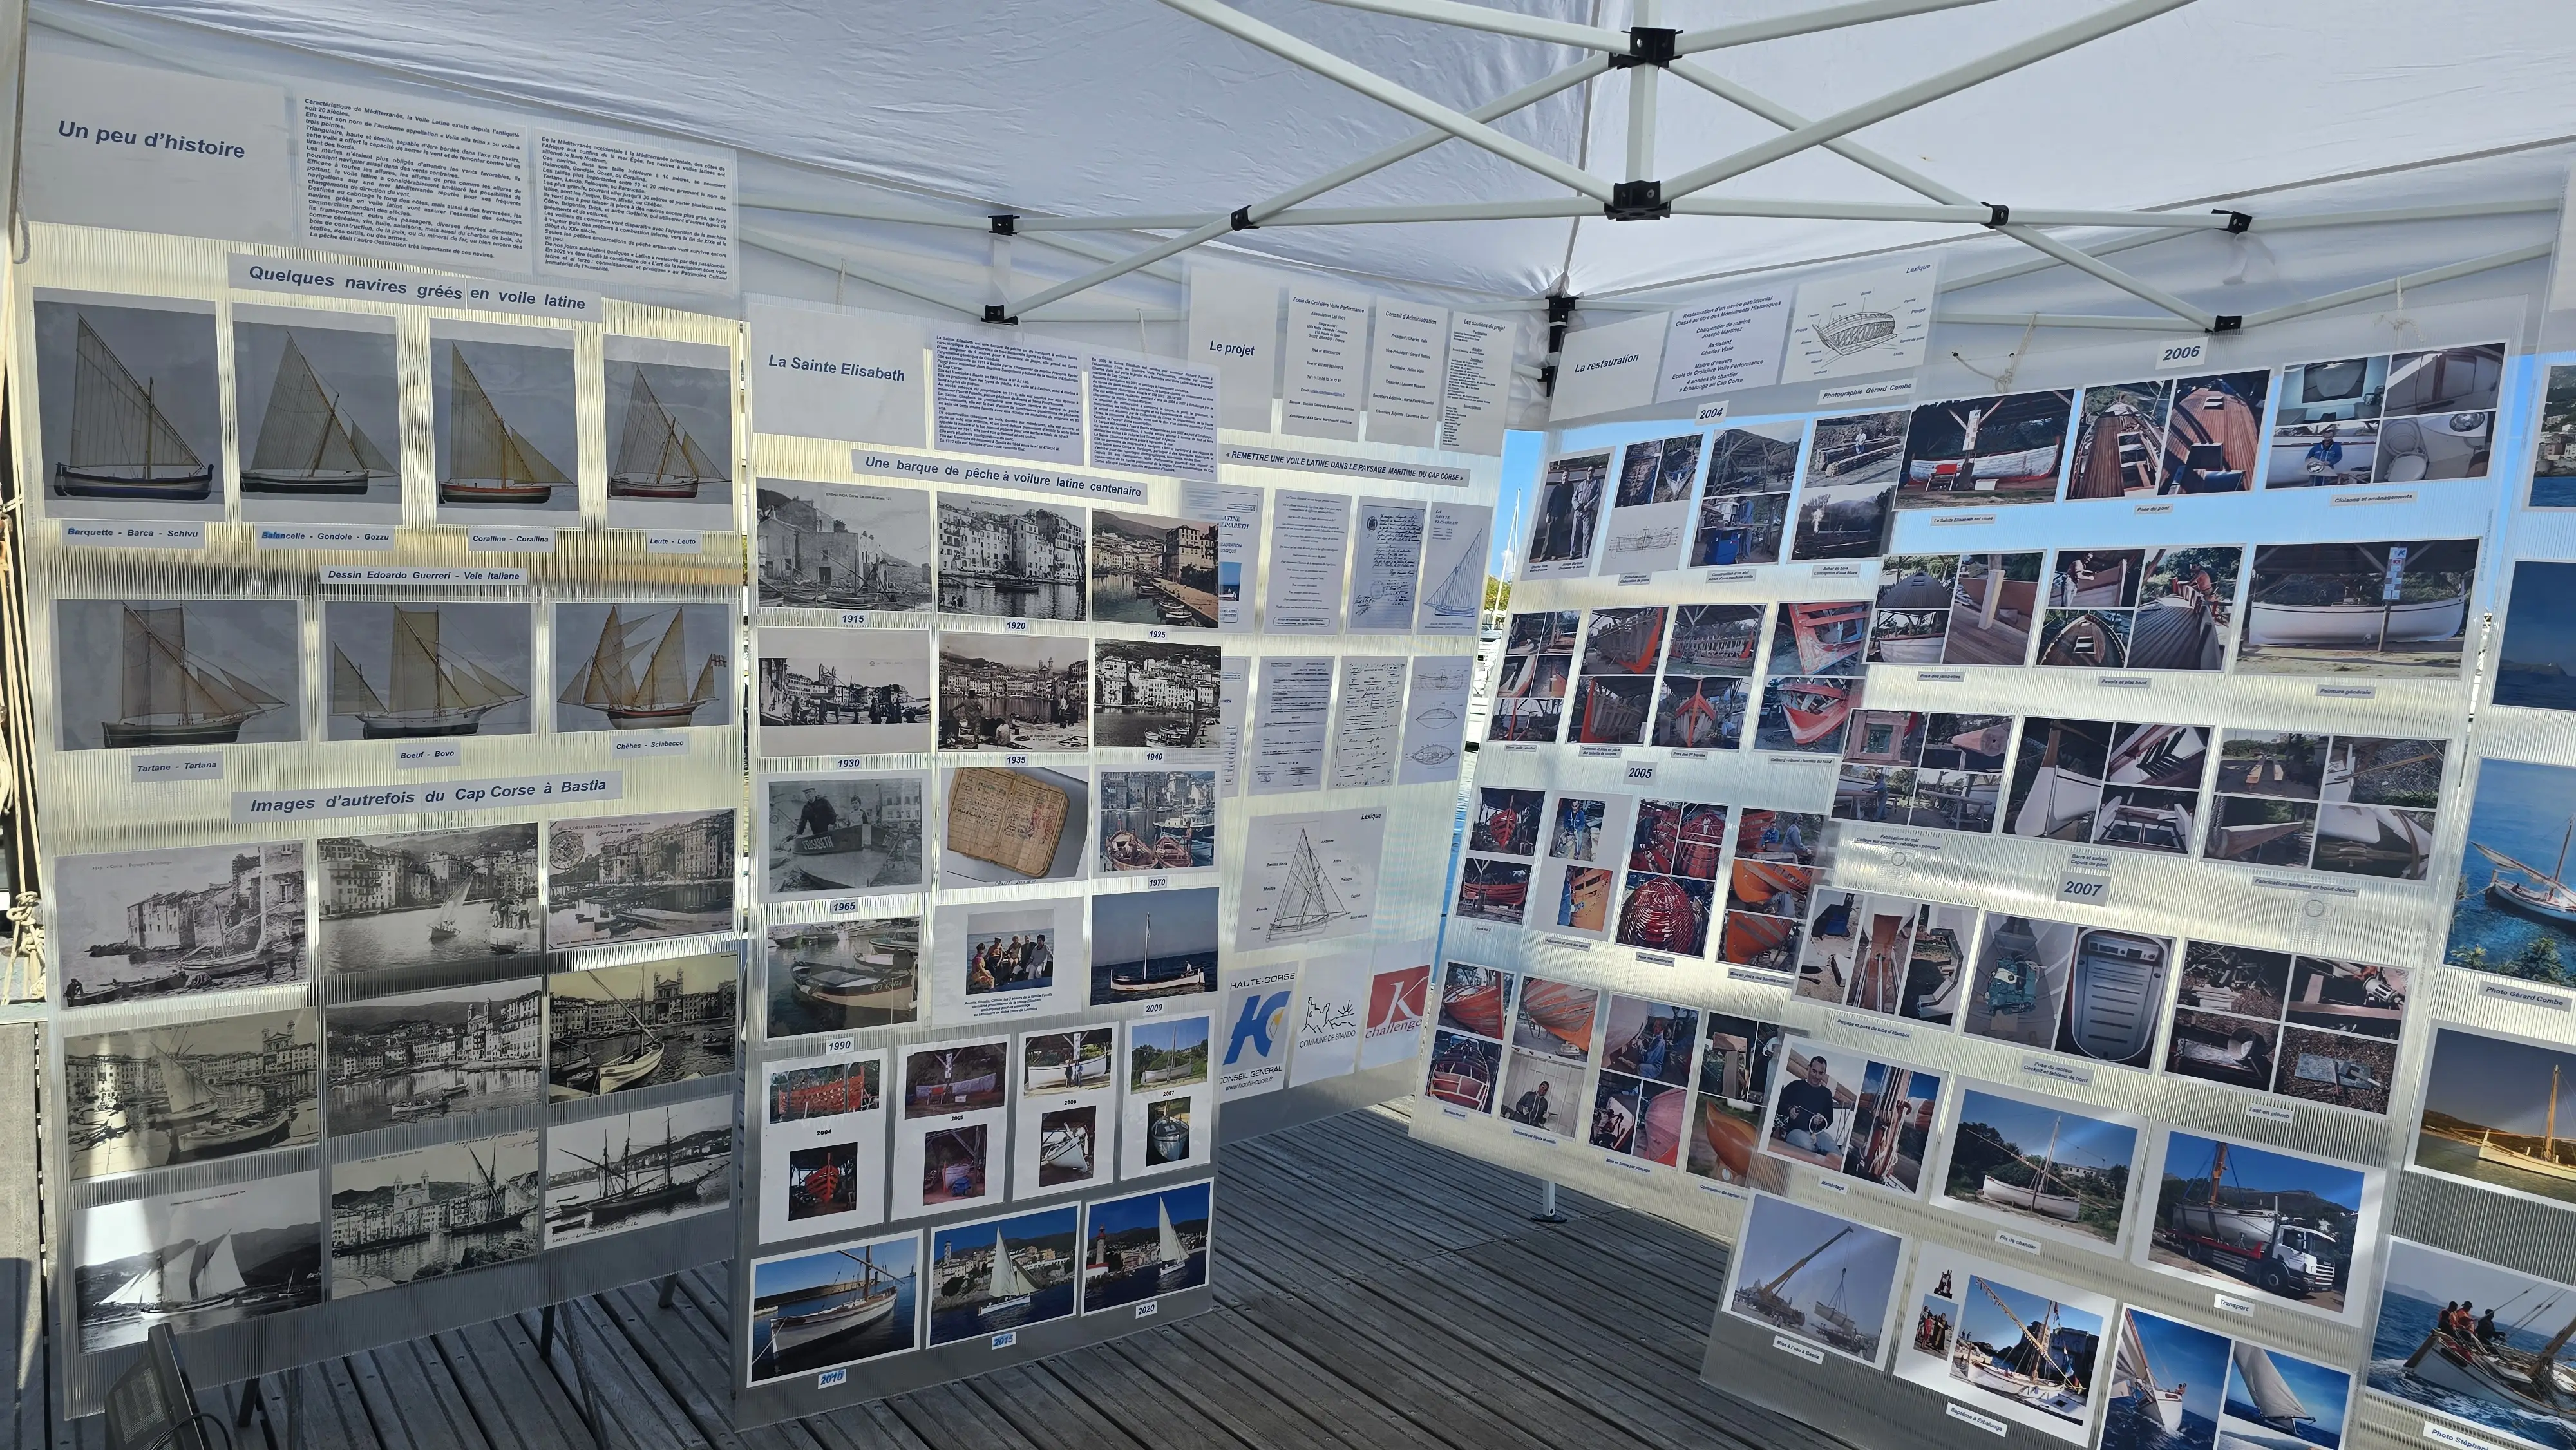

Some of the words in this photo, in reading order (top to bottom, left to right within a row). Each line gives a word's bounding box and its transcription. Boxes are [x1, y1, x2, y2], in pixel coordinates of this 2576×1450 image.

[59, 120, 88, 138] Un
[96, 129, 137, 144] peu
[1906, 265, 1930, 273] Lexique
[250, 266, 334, 286] Quelques
[345, 279, 407, 294] navires
[417, 285, 462, 299] gréés
[471, 290, 489, 299] en
[499, 291, 535, 304] voile
[545, 294, 585, 309] latine
[1210, 341, 1222, 352] Le
[1225, 344, 1255, 357] projet
[1708, 339, 1732, 348] Assistant
[2163, 346, 2200, 361] 2006
[769, 355, 786, 367] La
[791, 357, 836, 373] Sainte
[841, 363, 904, 381] Elisabeth
[1575, 364, 1585, 373] La
[1587, 354, 1639, 370] restauration
[1823, 390, 1862, 399] Photographie
[1700, 408, 1723, 419] 2004
[1232, 451, 1269, 461] REMETTRE
[1287, 457, 1305, 465] VOILE
[1307, 459, 1329, 467] LATINE
[1358, 464, 1386, 473] PAYSAGE
[1388, 467, 1416, 476] MARITIME
[866, 457, 889, 468] Une
[897, 460, 938, 474] barque
[945, 466, 959, 475] de
[965, 468, 999, 480] pêche
[1003, 471, 1009, 481] à
[1014, 473, 1050, 485] voilure
[1057, 477, 1084, 489] latine
[1090, 484, 1141, 496] centenaire
[68, 528, 113, 536] Barquette
[838, 759, 859, 767] 1930
[1629, 768, 1652, 778] 2005
[251, 800, 315, 813] Images
[425, 791, 444, 802] du
[455, 789, 485, 802] Cap
[491, 786, 535, 797] Corse
[544, 782, 552, 793] à
[562, 780, 605, 792] Bastia
[2064, 881, 2102, 896] 2007
[834, 902, 855, 911] 1965
[1230, 973, 1295, 989] HAUTE-CORSE
[2510, 992, 2535, 1000] Gérard
[2537, 997, 2563, 1006] Combe
[1146, 1004, 1162, 1012] 2000
[1365, 1019, 1422, 1038] challenge
[1300, 1036, 1327, 1048] COMMUNE
[1336, 1030, 1356, 1040] BRANDO
[829, 1041, 851, 1051] 1990
[1251, 1066, 1282, 1077] GENERAL
[1821, 1181, 1844, 1191] Matelotage
[2016, 1241, 2036, 1249] chantier
[1138, 1304, 1155, 1315] 2020
[2221, 1299, 2249, 1312] Transport
[993, 1334, 1013, 1346] 2015
[820, 1370, 843, 1384] 2010
[1951, 1408, 1972, 1419] Baptême
[1977, 1418, 2002, 1431] Erbalunga
[2432, 1429, 2453, 1440] Photo
